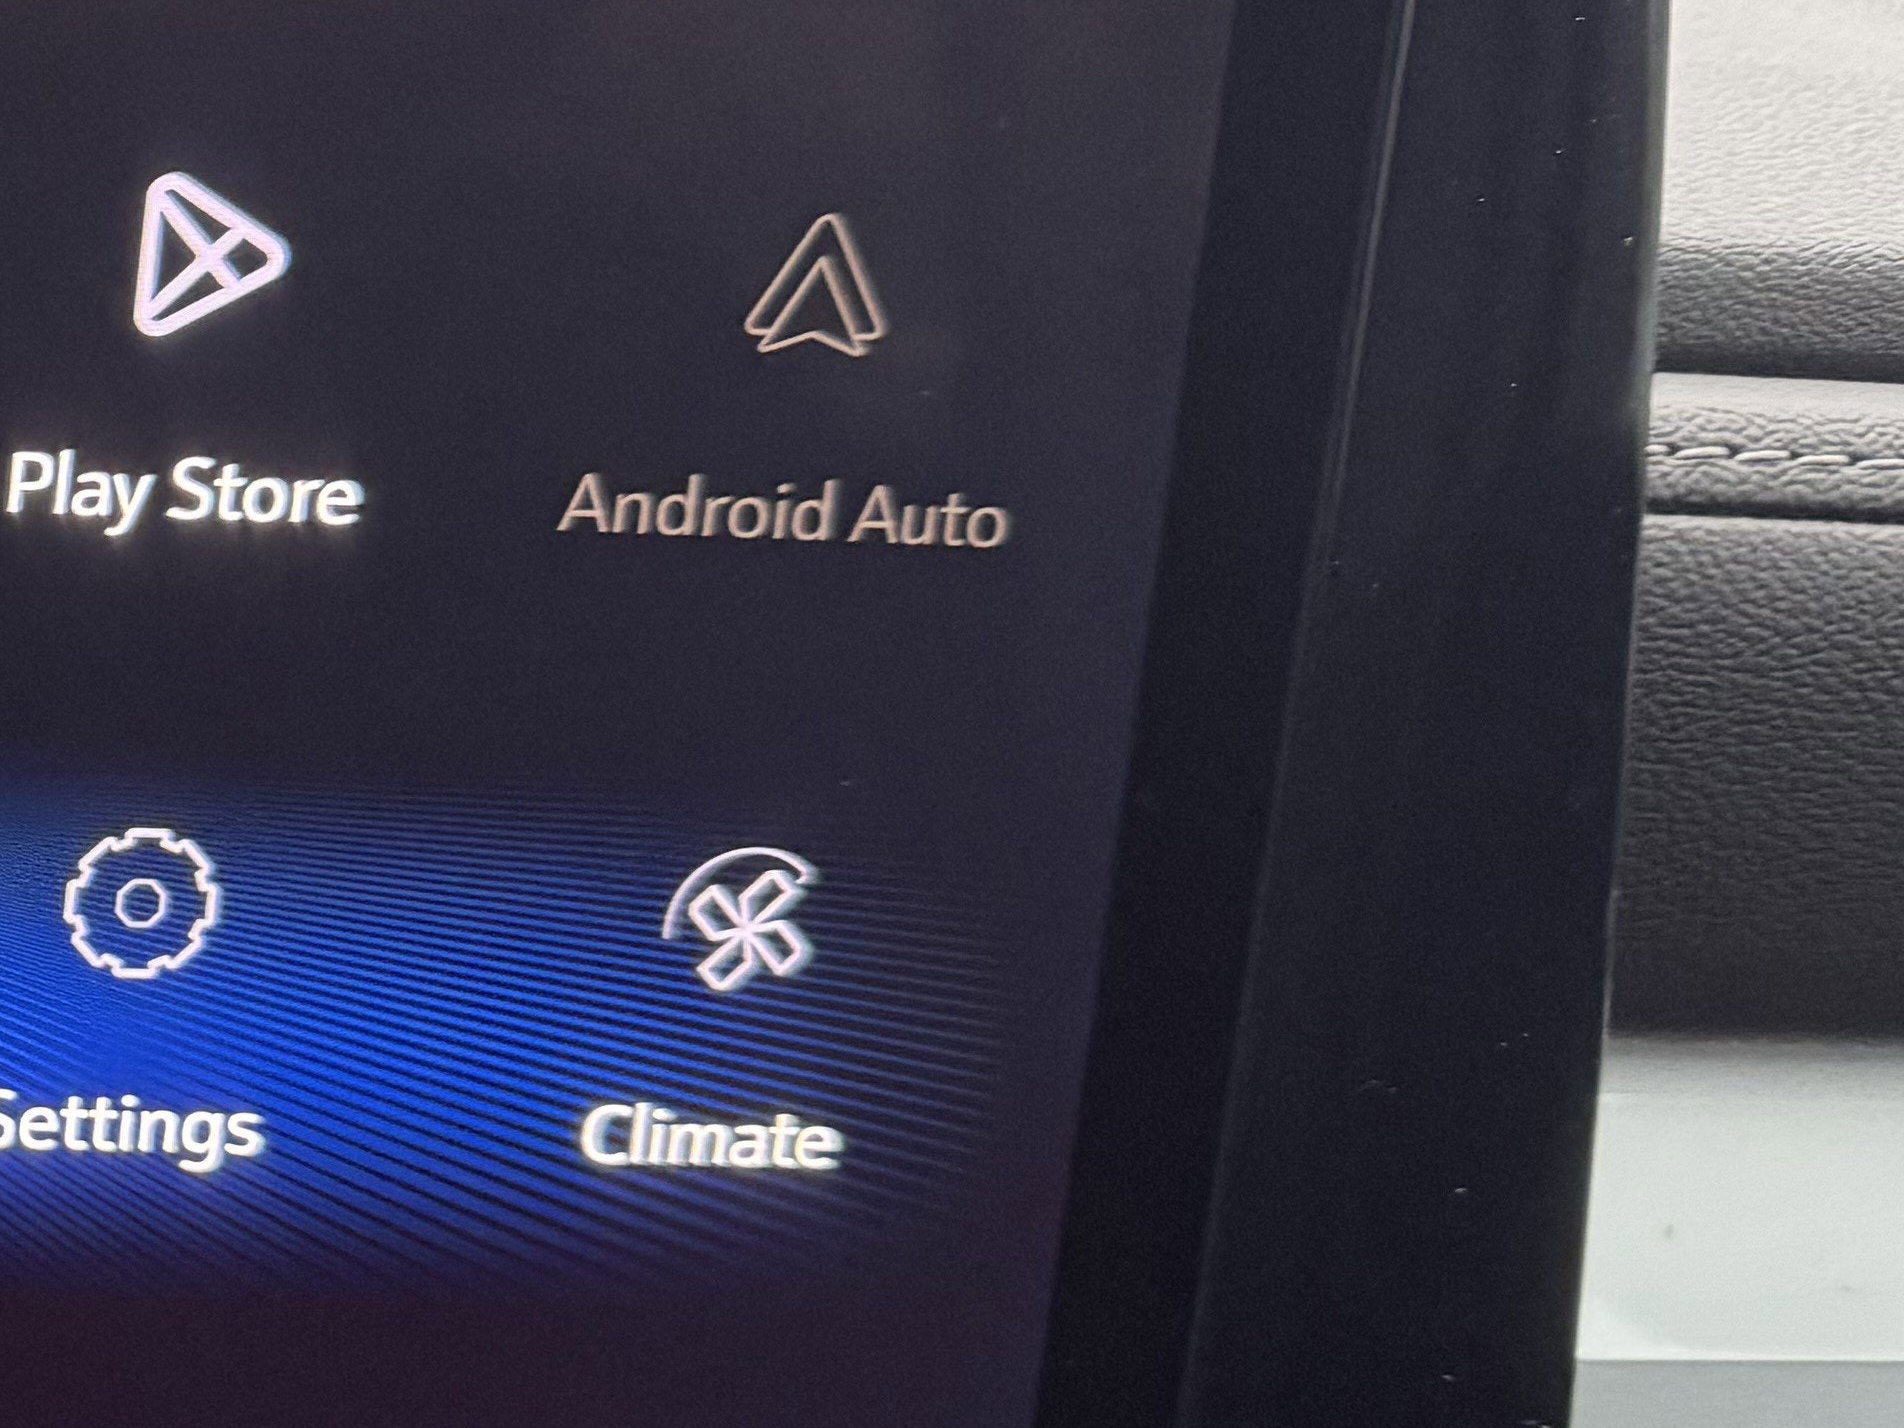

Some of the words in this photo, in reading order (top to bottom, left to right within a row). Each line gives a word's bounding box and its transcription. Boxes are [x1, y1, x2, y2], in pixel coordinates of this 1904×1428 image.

[4, 450, 156, 530] Play
[169, 460, 364, 528] Store
[557, 472, 840, 546] Android
[848, 484, 1010, 550] Auto
[577, 1100, 844, 1177] Climate
